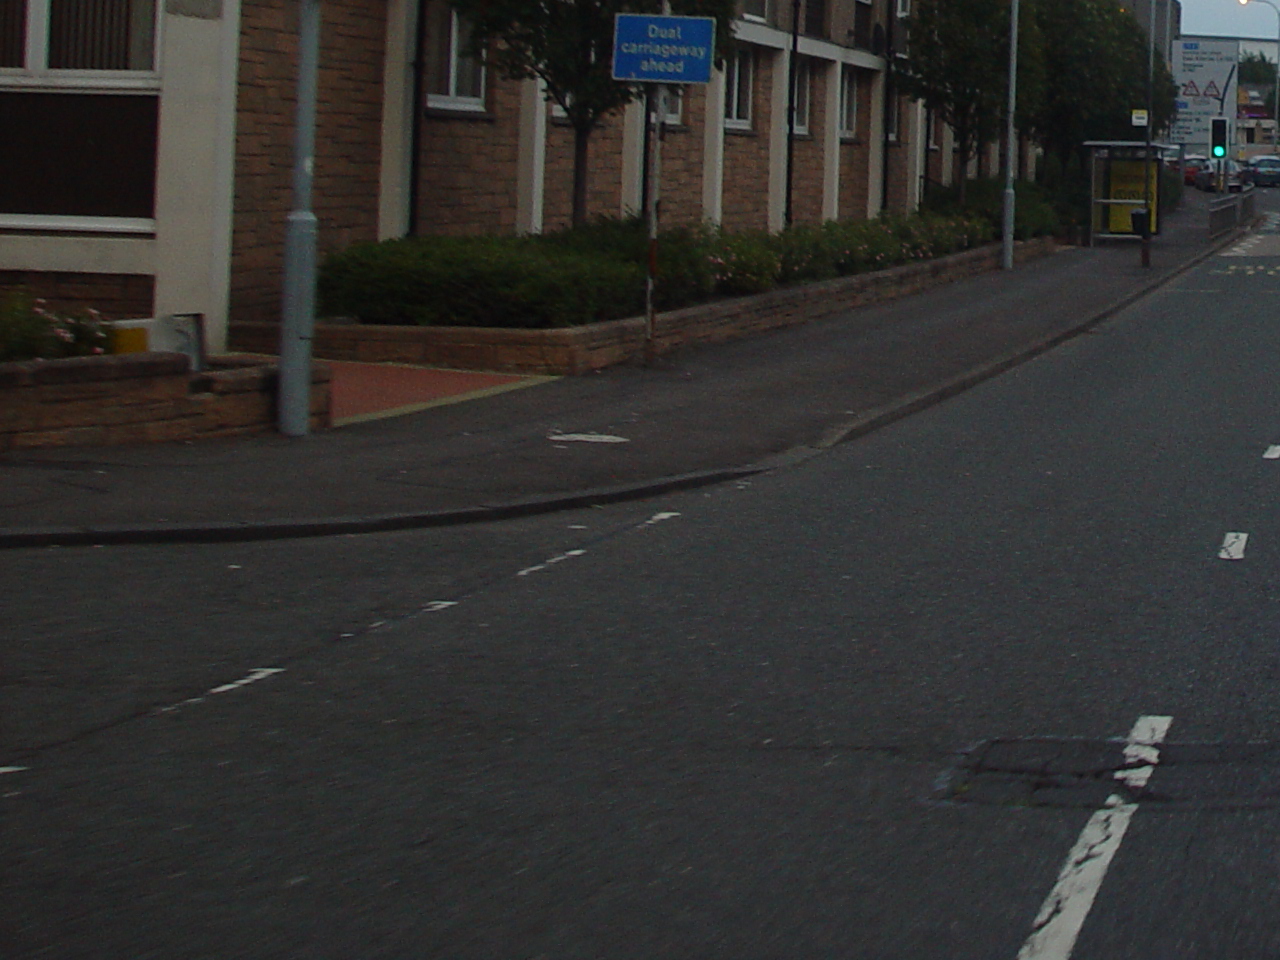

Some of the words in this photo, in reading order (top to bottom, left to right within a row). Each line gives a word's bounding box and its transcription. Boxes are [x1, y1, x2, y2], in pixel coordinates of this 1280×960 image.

[648, 24, 682, 39] Dual
[621, 41, 706, 60] carriageway
[640, 58, 684, 73] ahead
